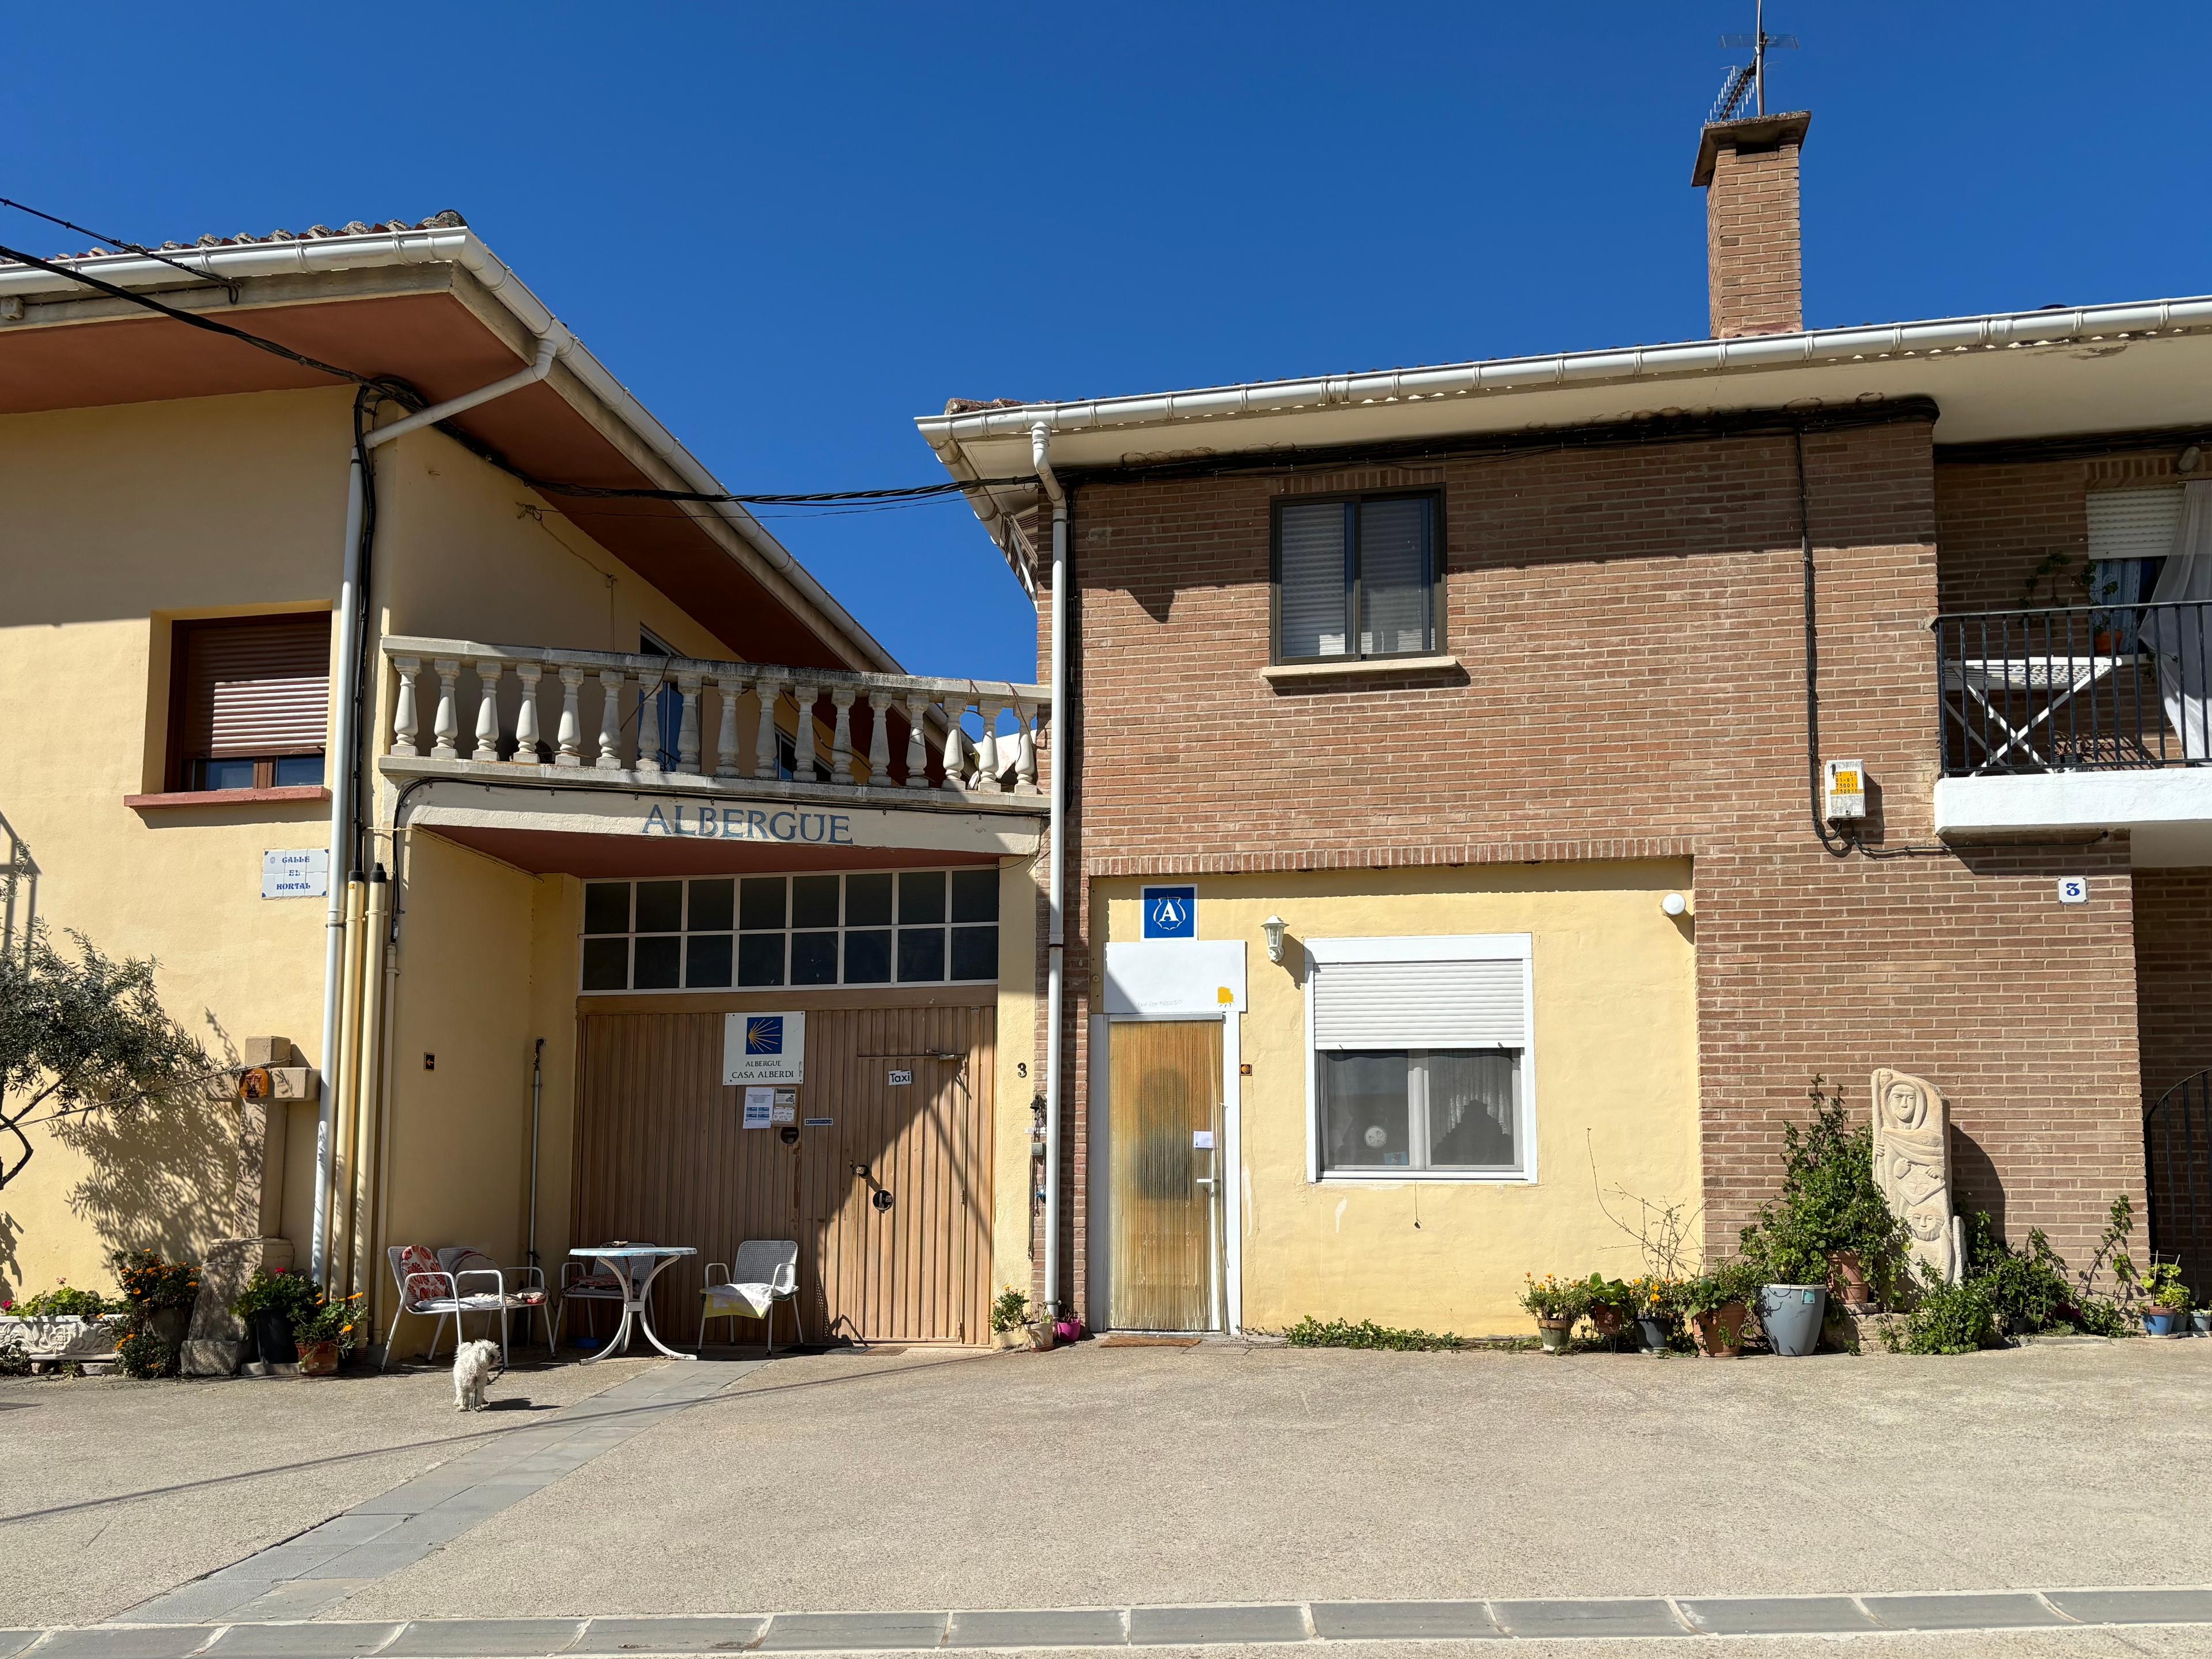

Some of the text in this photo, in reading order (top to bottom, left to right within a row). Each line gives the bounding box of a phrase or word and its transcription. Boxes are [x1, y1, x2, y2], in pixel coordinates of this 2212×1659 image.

[641, 804, 854, 844] ALBERGUE
[2066, 882, 2080, 896] 3
[1158, 897, 1180, 922] A
[889, 1072, 910, 1082] Taxi
[1017, 1062, 1027, 1078] 3
